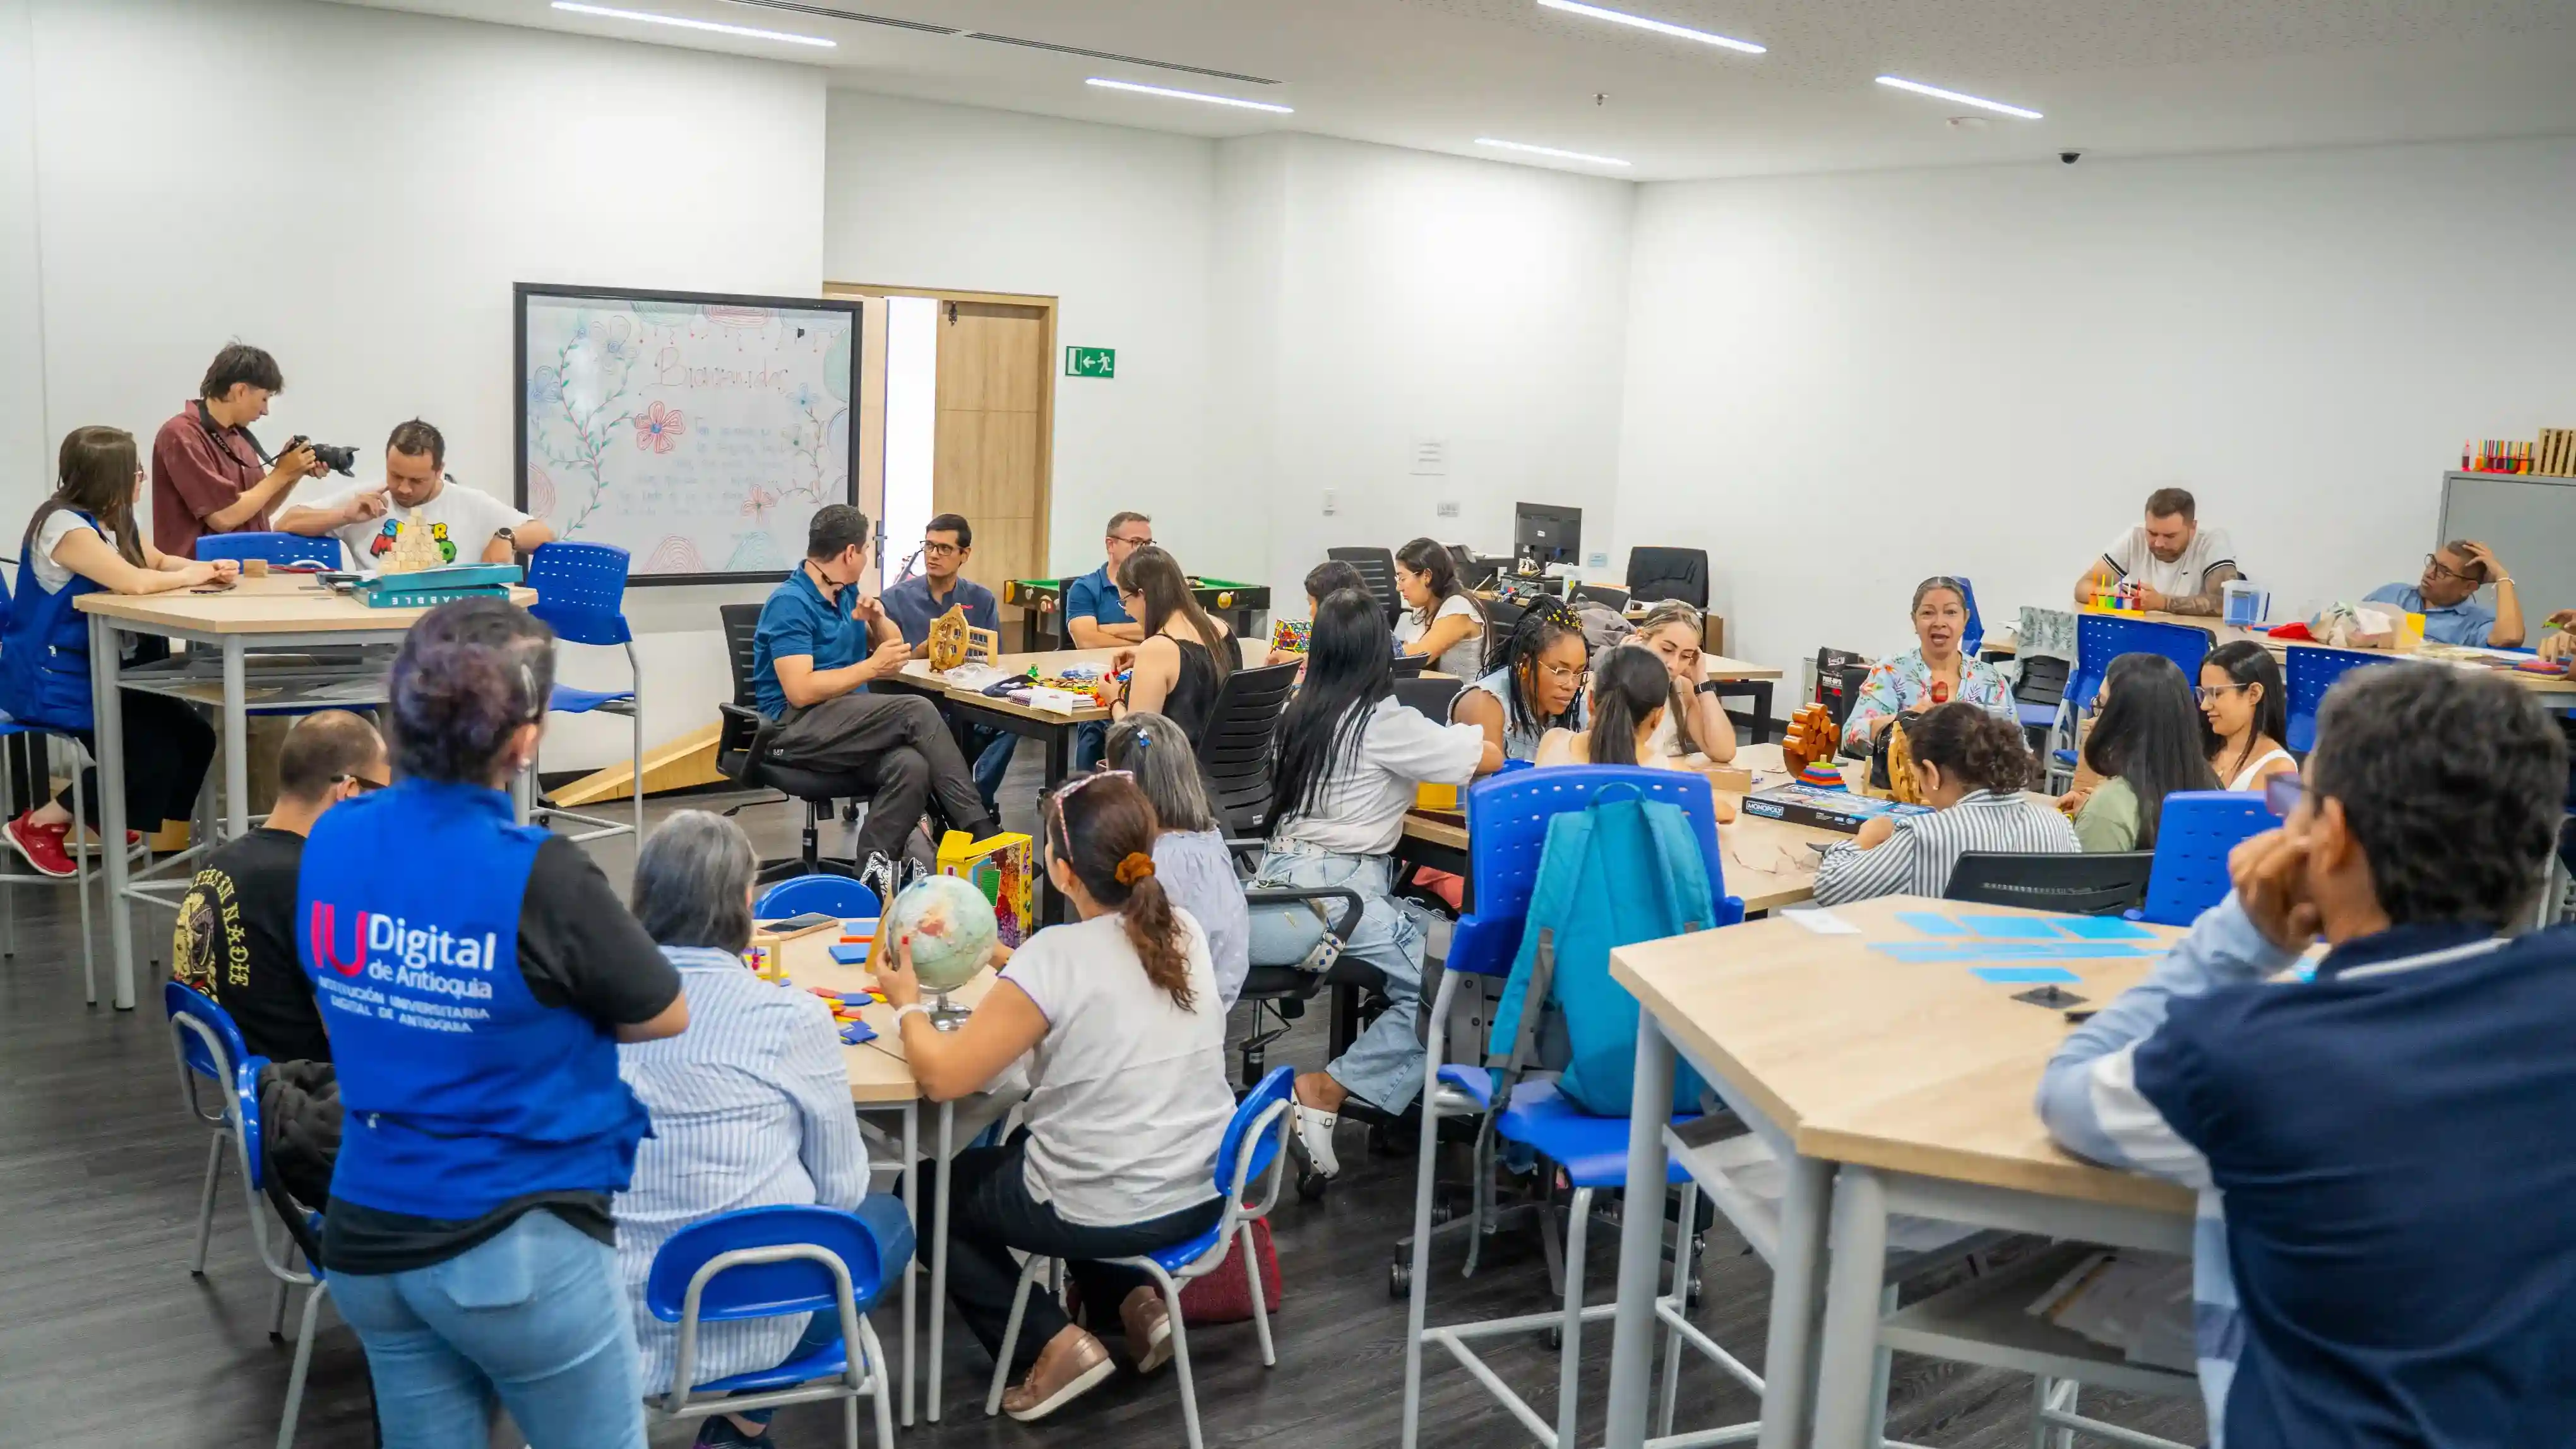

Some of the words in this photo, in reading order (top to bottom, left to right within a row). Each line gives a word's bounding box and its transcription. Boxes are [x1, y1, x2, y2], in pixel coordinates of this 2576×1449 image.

[392, 594, 487, 605] RABBLE
[1747, 802, 1782, 814] MONOPOLY
[222, 902, 251, 986] NADIE
[368, 914, 497, 970] Digital
[368, 958, 393, 982] de
[396, 965, 492, 1000] Antioquia
[378, 1006, 394, 1020] DE
